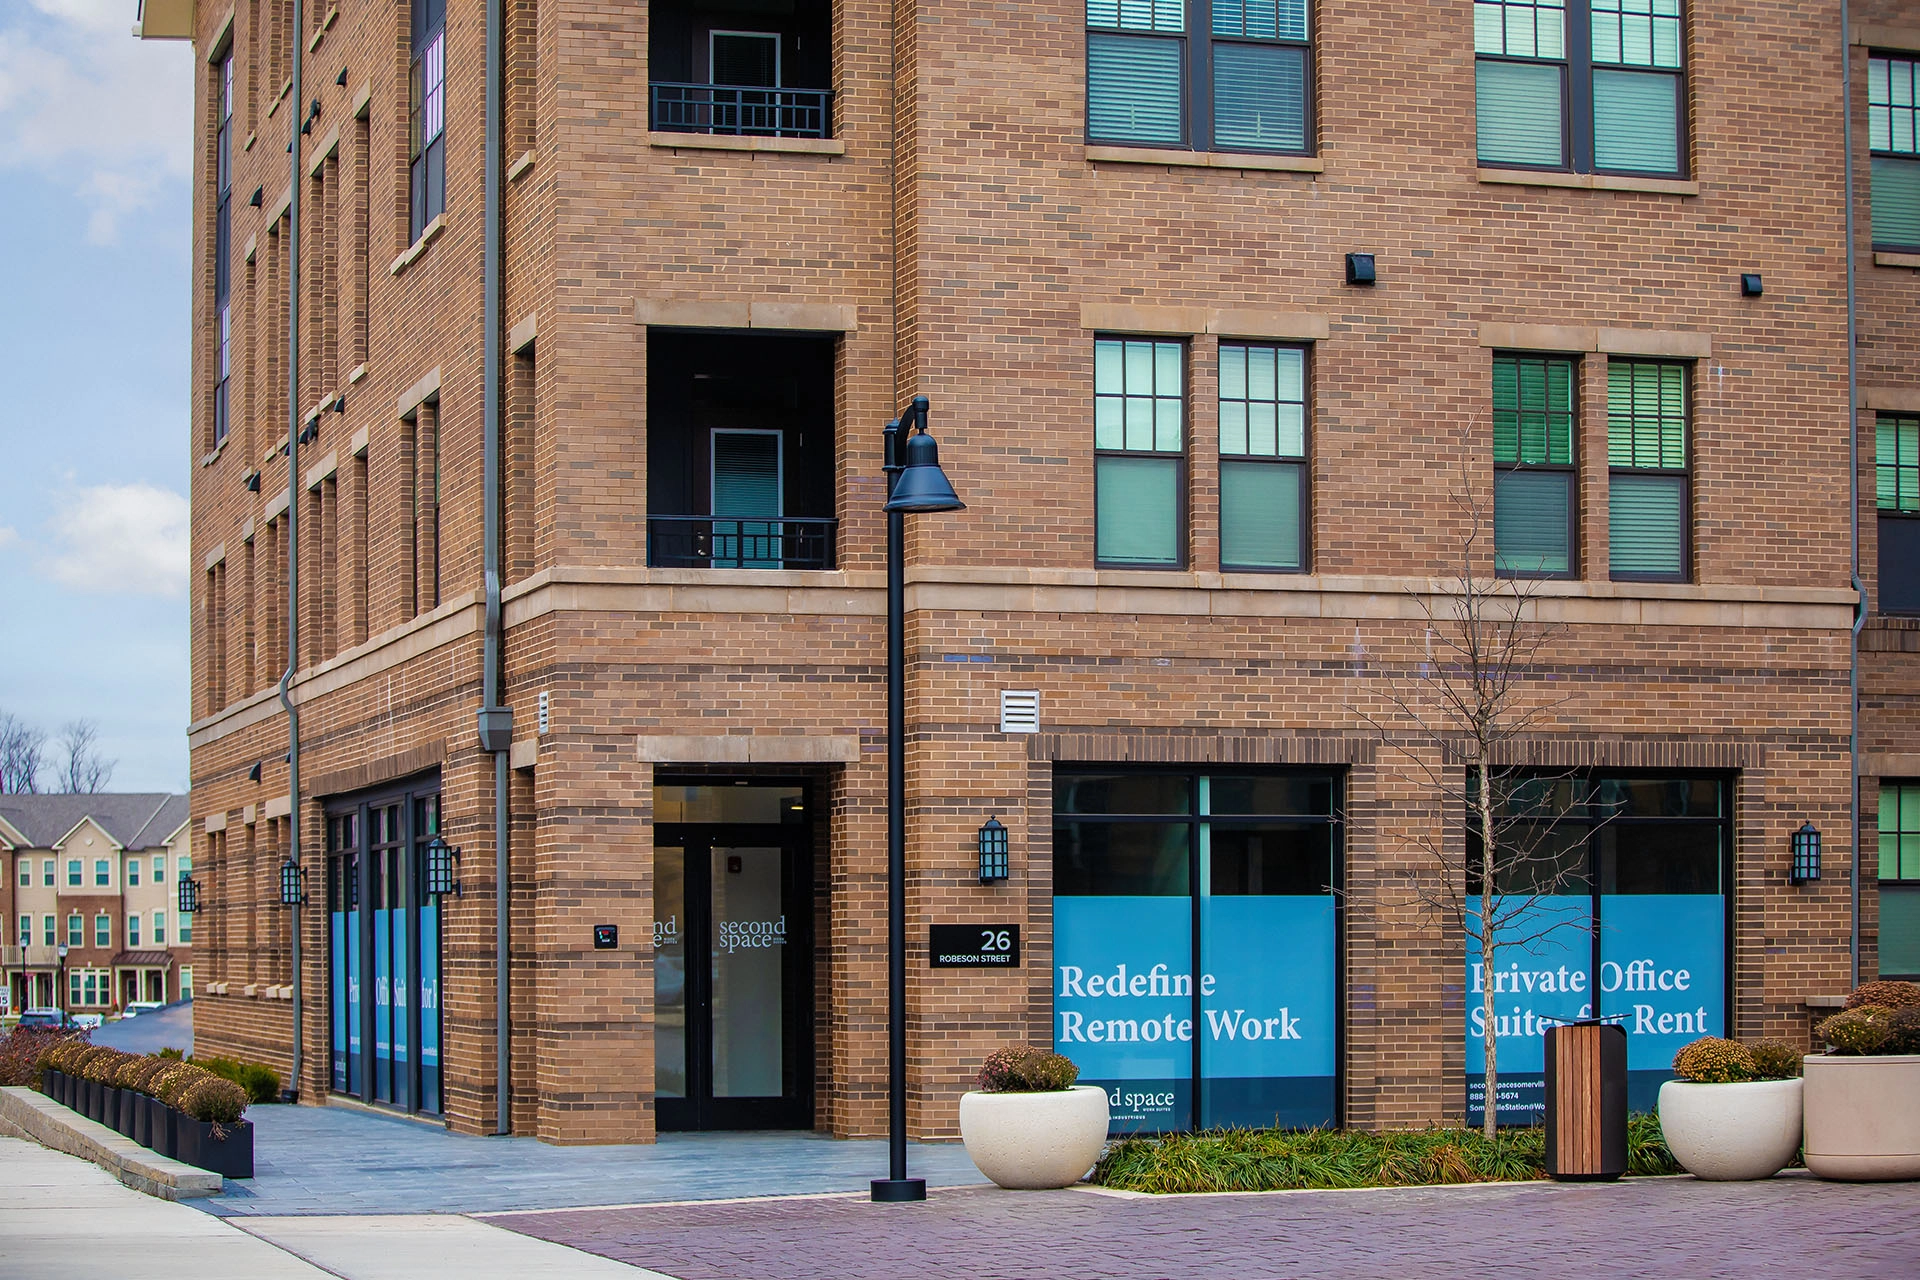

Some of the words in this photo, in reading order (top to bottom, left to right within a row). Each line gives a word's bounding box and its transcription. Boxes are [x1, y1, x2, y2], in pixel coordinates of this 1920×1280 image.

[720, 915, 787, 934] second
[720, 934, 772, 953] space
[981, 931, 1011, 951] 26
[1059, 963, 1216, 997] Redefine
[1601, 959, 1690, 991] Office
[1059, 1011, 1192, 1042] Remote
[1204, 1007, 1302, 1040] Work
[1633, 1004, 1707, 1034] Rent
[1125, 1093, 1174, 1112] space
